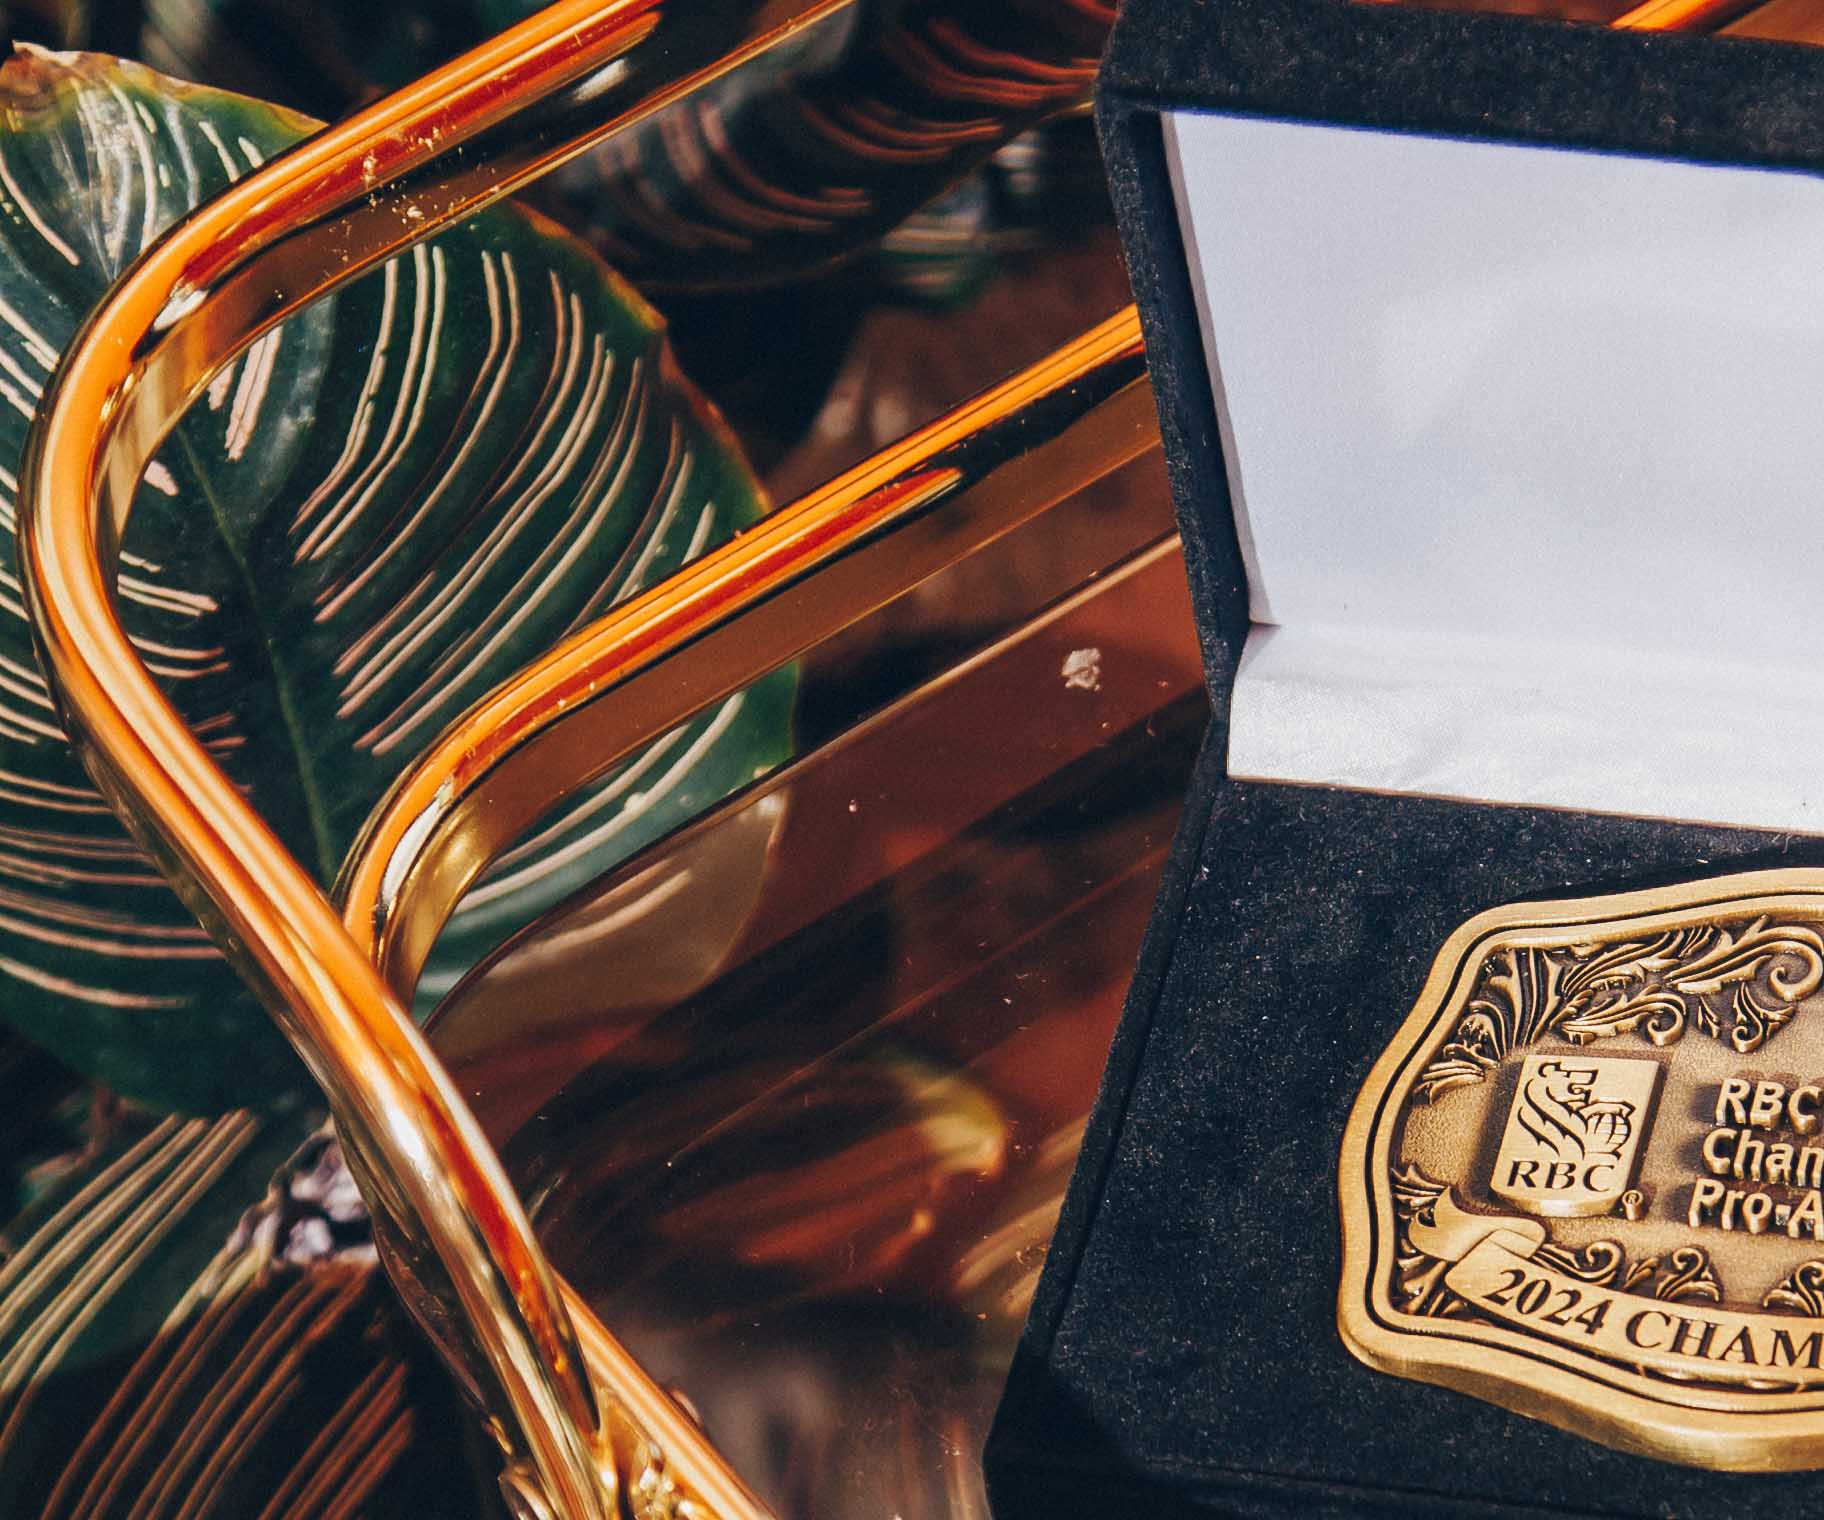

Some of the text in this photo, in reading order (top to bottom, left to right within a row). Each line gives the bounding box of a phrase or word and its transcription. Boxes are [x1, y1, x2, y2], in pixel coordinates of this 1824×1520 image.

[1715, 1078, 1821, 1132] RBC
[1506, 1160, 1616, 1193] RBC
[1481, 1267, 1614, 1336] 2024
